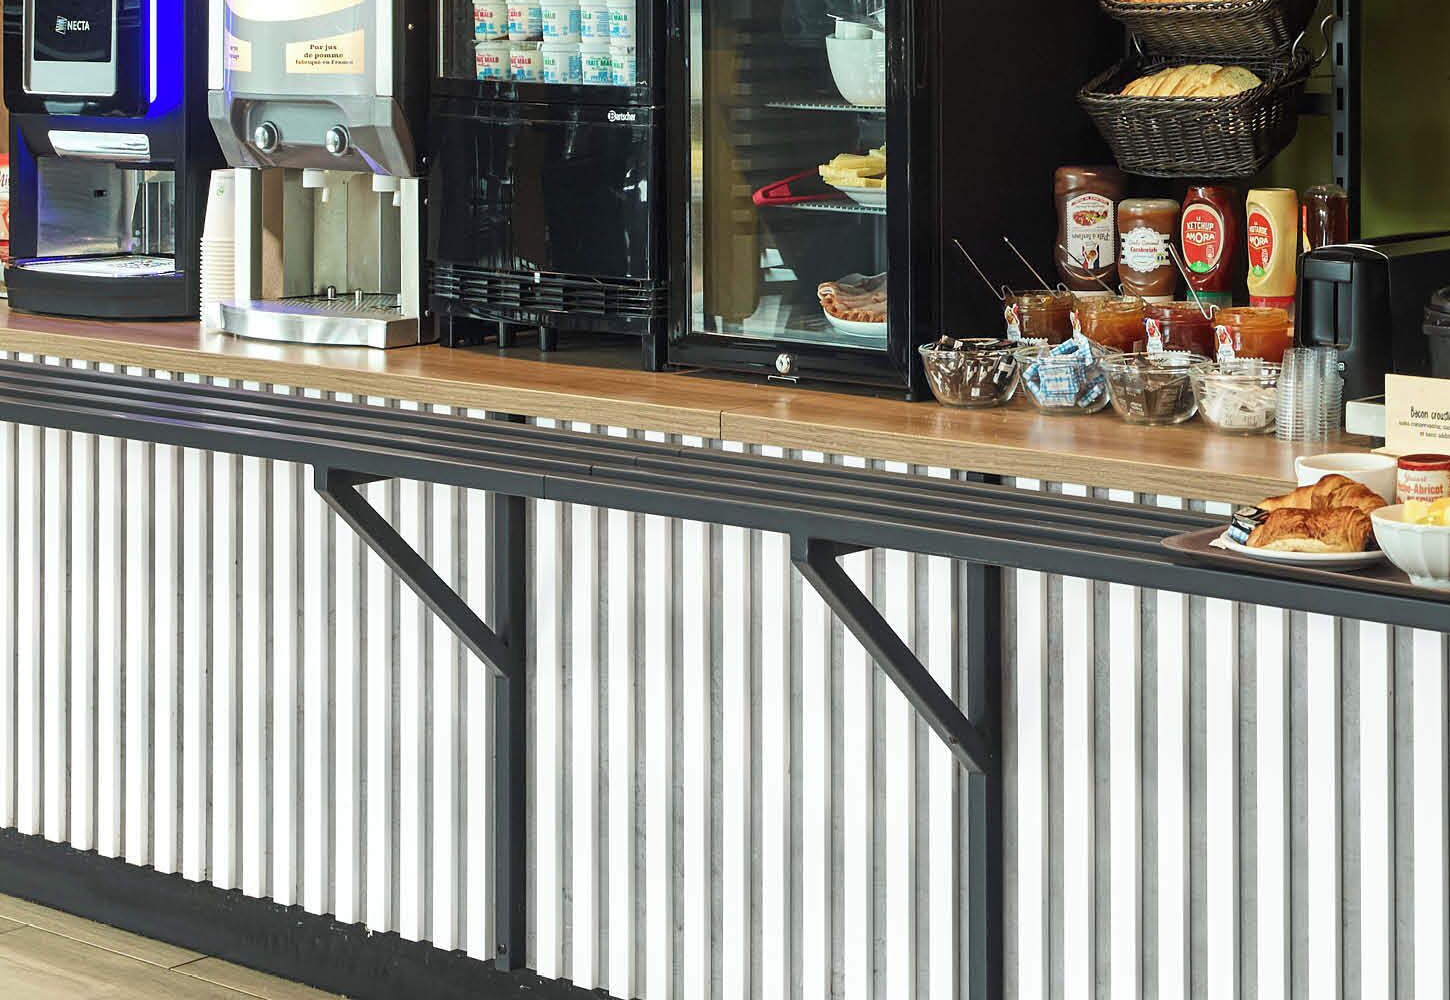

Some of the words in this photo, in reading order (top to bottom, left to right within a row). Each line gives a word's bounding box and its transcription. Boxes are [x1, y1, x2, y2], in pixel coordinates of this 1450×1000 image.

[67, 20, 90, 31] NECTA
[314, 52, 344, 60] pomme
[1187, 222, 1214, 230] KETCHUP
[1186, 232, 1215, 244] AMORA
[1410, 406, 1428, 419] Bacon
